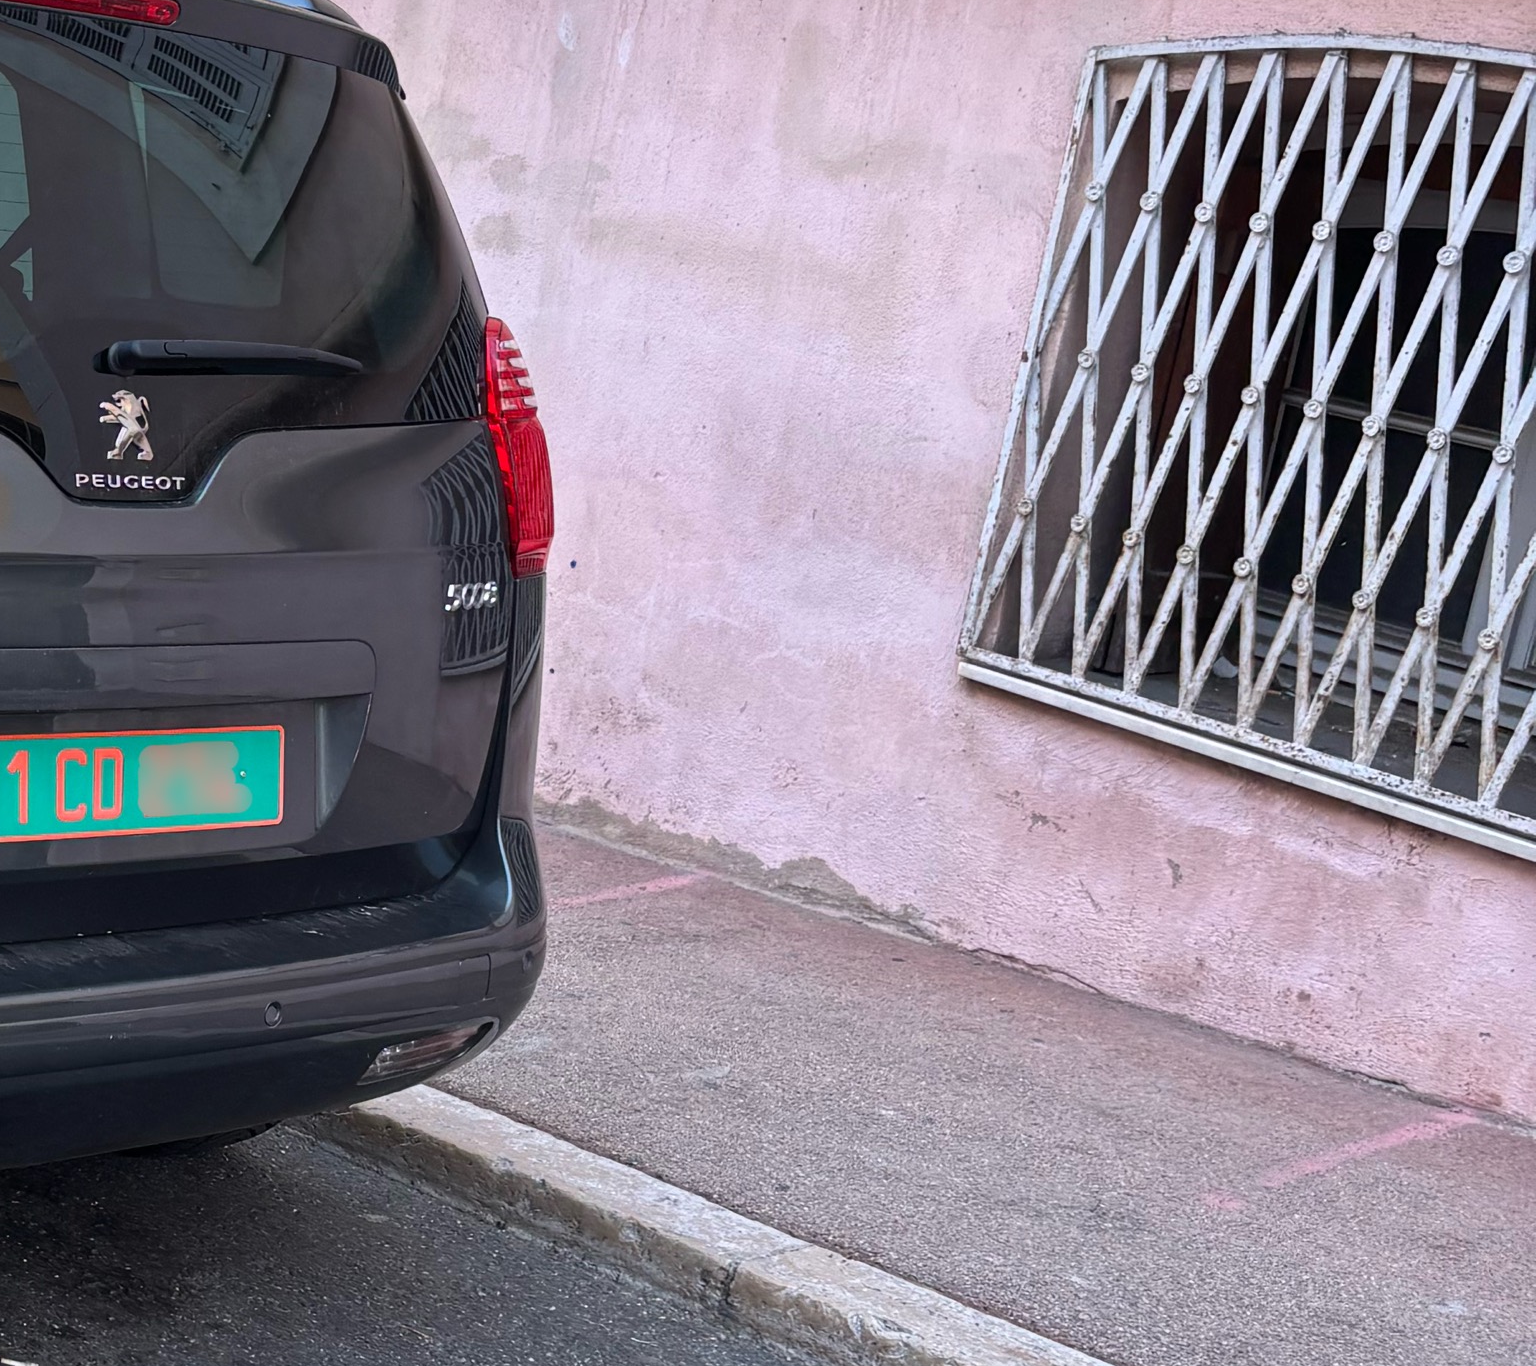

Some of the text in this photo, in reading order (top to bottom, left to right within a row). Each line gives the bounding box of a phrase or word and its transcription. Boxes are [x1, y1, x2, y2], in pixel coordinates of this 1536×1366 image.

[76, 473, 185, 490] PEUGEOT
[445, 581, 498, 612] 5008
[56, 747, 124, 822] CD
